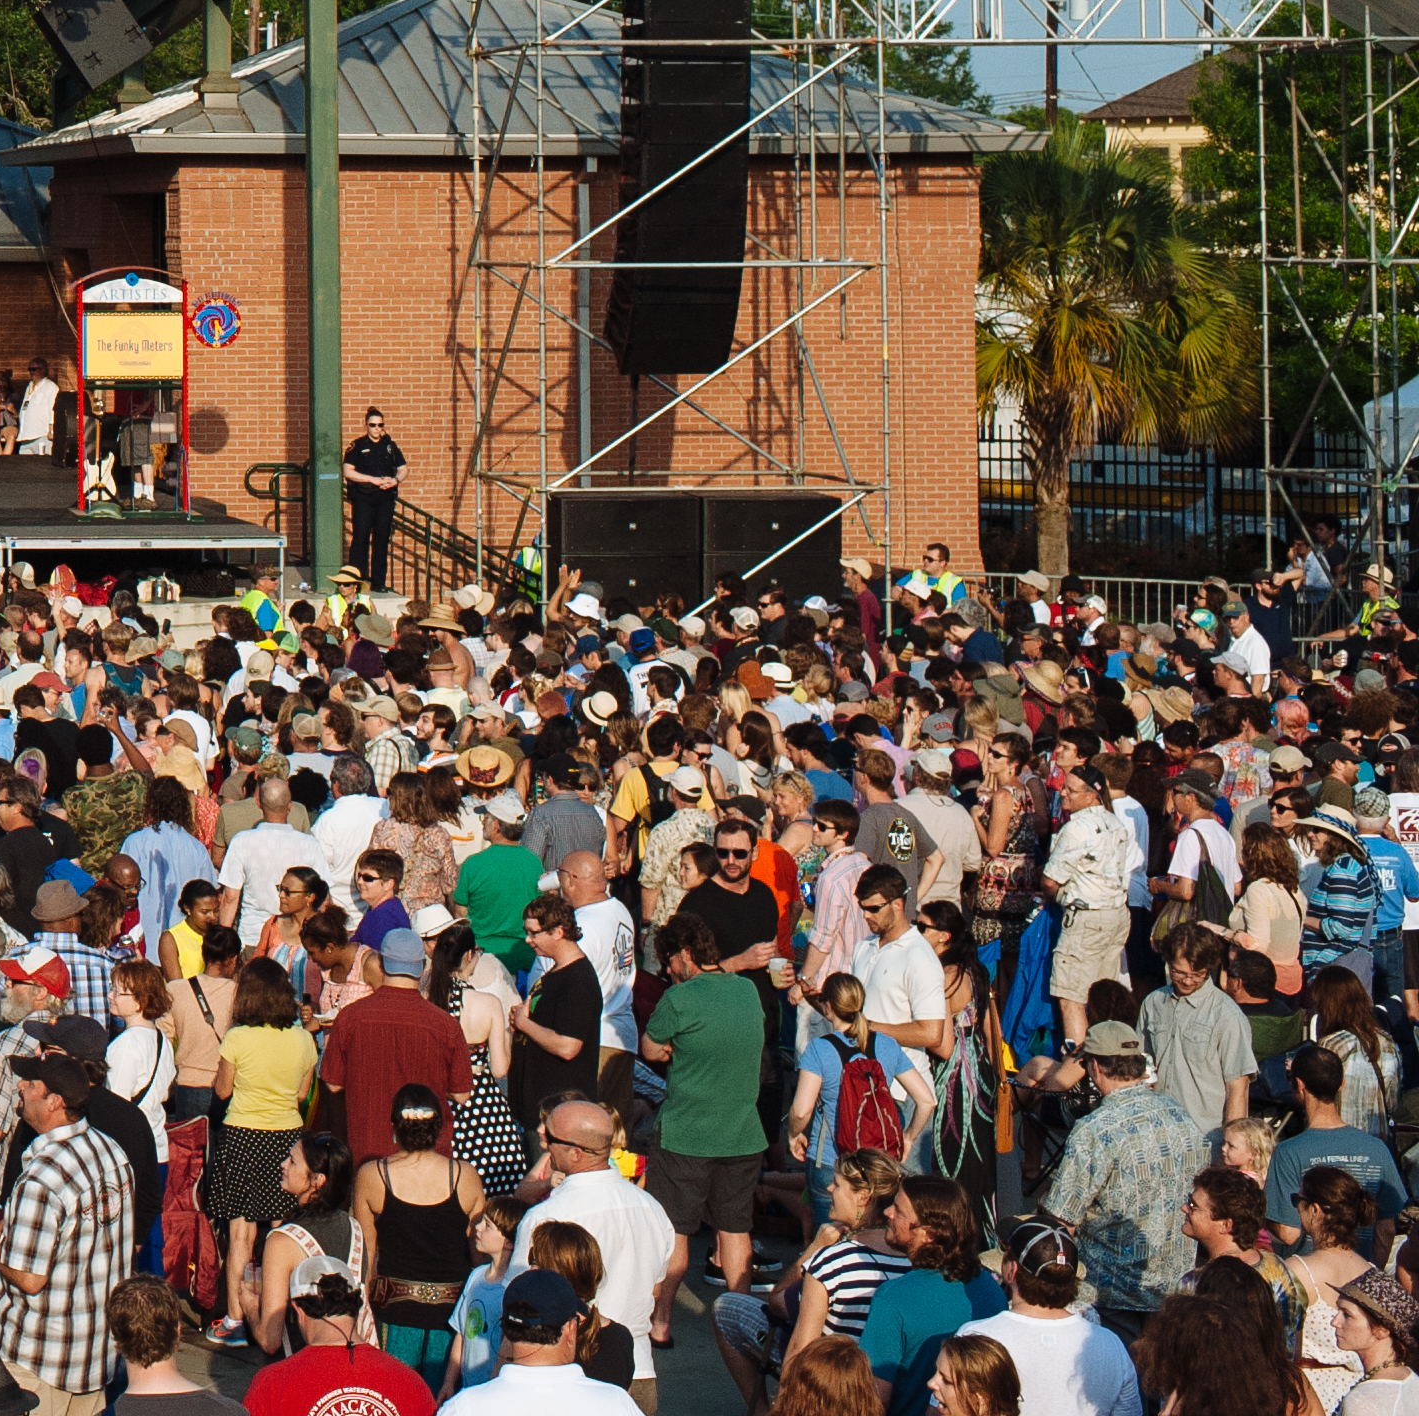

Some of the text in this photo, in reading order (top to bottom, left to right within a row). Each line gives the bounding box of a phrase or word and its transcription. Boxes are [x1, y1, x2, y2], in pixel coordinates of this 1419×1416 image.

[99, 287, 168, 301] ARTISTES
[96, 339, 173, 354] The Funky Meters
